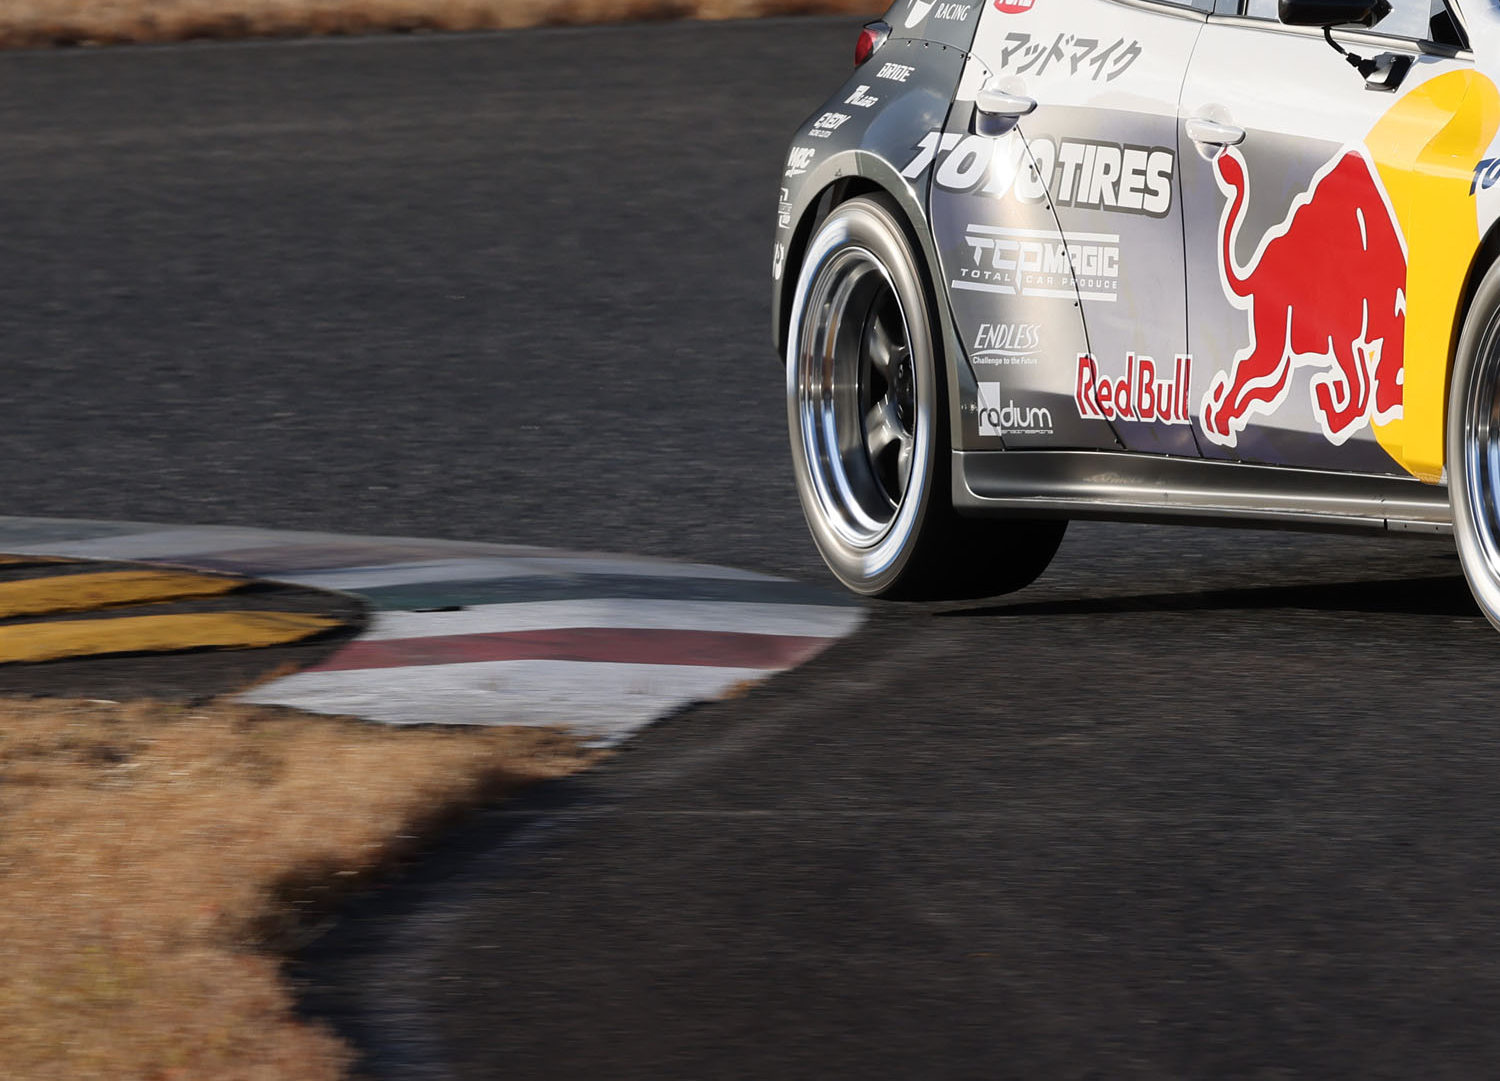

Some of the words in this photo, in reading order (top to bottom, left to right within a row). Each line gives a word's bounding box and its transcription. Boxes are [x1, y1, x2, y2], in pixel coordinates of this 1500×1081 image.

[935, 3, 971, 21] RACING
[1001, 32, 1142, 82] マッドマイク
[877, 63, 915, 82] BRIDE
[814, 112, 851, 129] EXEDY
[960, 268, 1011, 281] TOTAL
[1026, 275, 1054, 285] CAR
[1062, 278, 1118, 289] PRODUCE
[974, 323, 1041, 349] ENDLESS
[973, 356, 1002, 366] Challenge
[1077, 354, 1135, 418] Red
[1137, 358, 1191, 422] Bull
[979, 399, 1053, 428] radium
